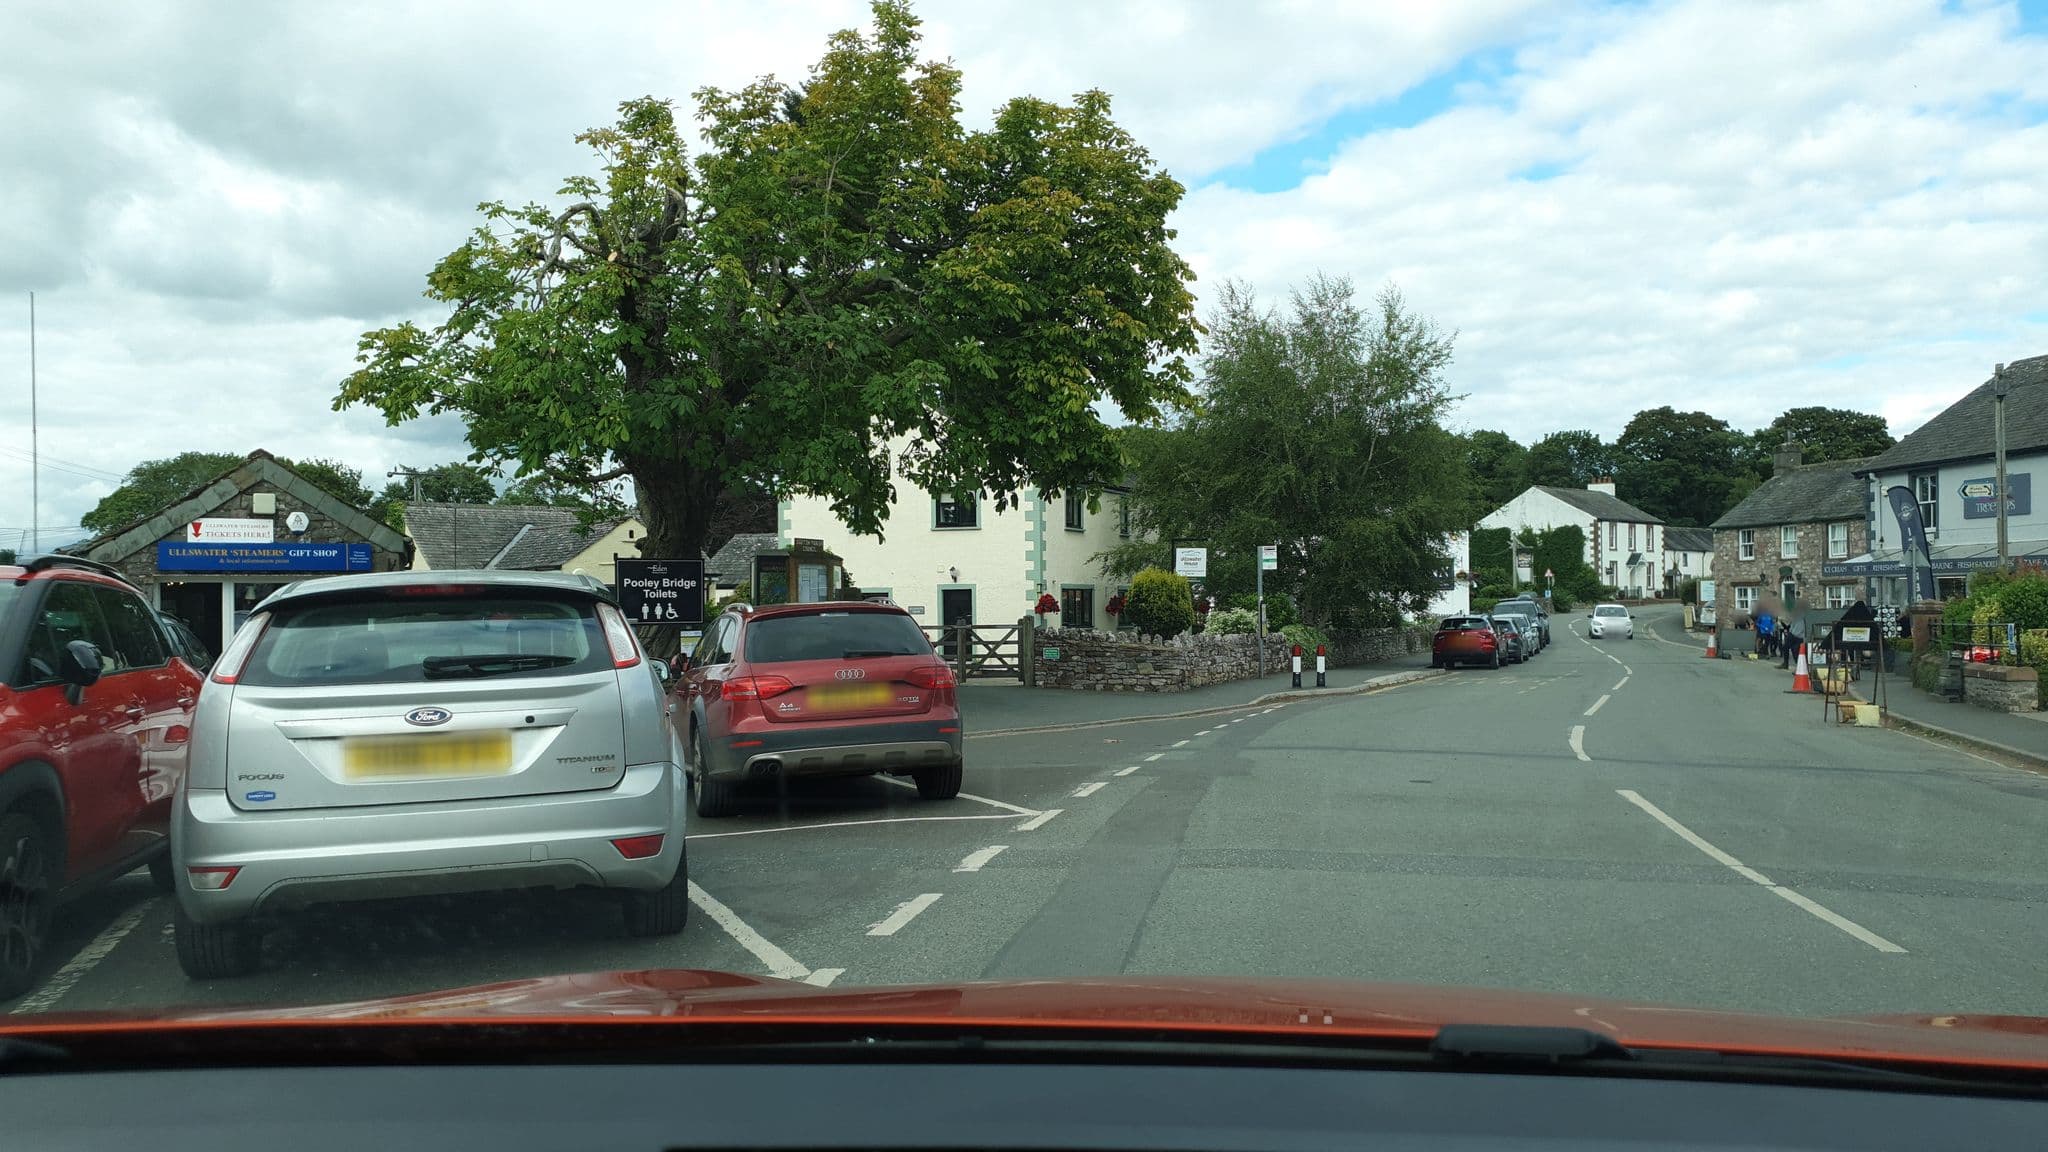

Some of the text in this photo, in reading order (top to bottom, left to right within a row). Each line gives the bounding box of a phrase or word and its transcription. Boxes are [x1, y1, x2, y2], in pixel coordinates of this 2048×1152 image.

[243, 531, 271, 539] HERE!
[168, 548, 228, 557] ULLSWATER
[288, 549, 312, 558] GIFT
[312, 549, 338, 558] SHOP
[623, 578, 697, 590] Pooley Bridge
[643, 589, 678, 599] Toilets
[556, 754, 616, 764] TITANIUM
[238, 773, 285, 782] FOCUS
